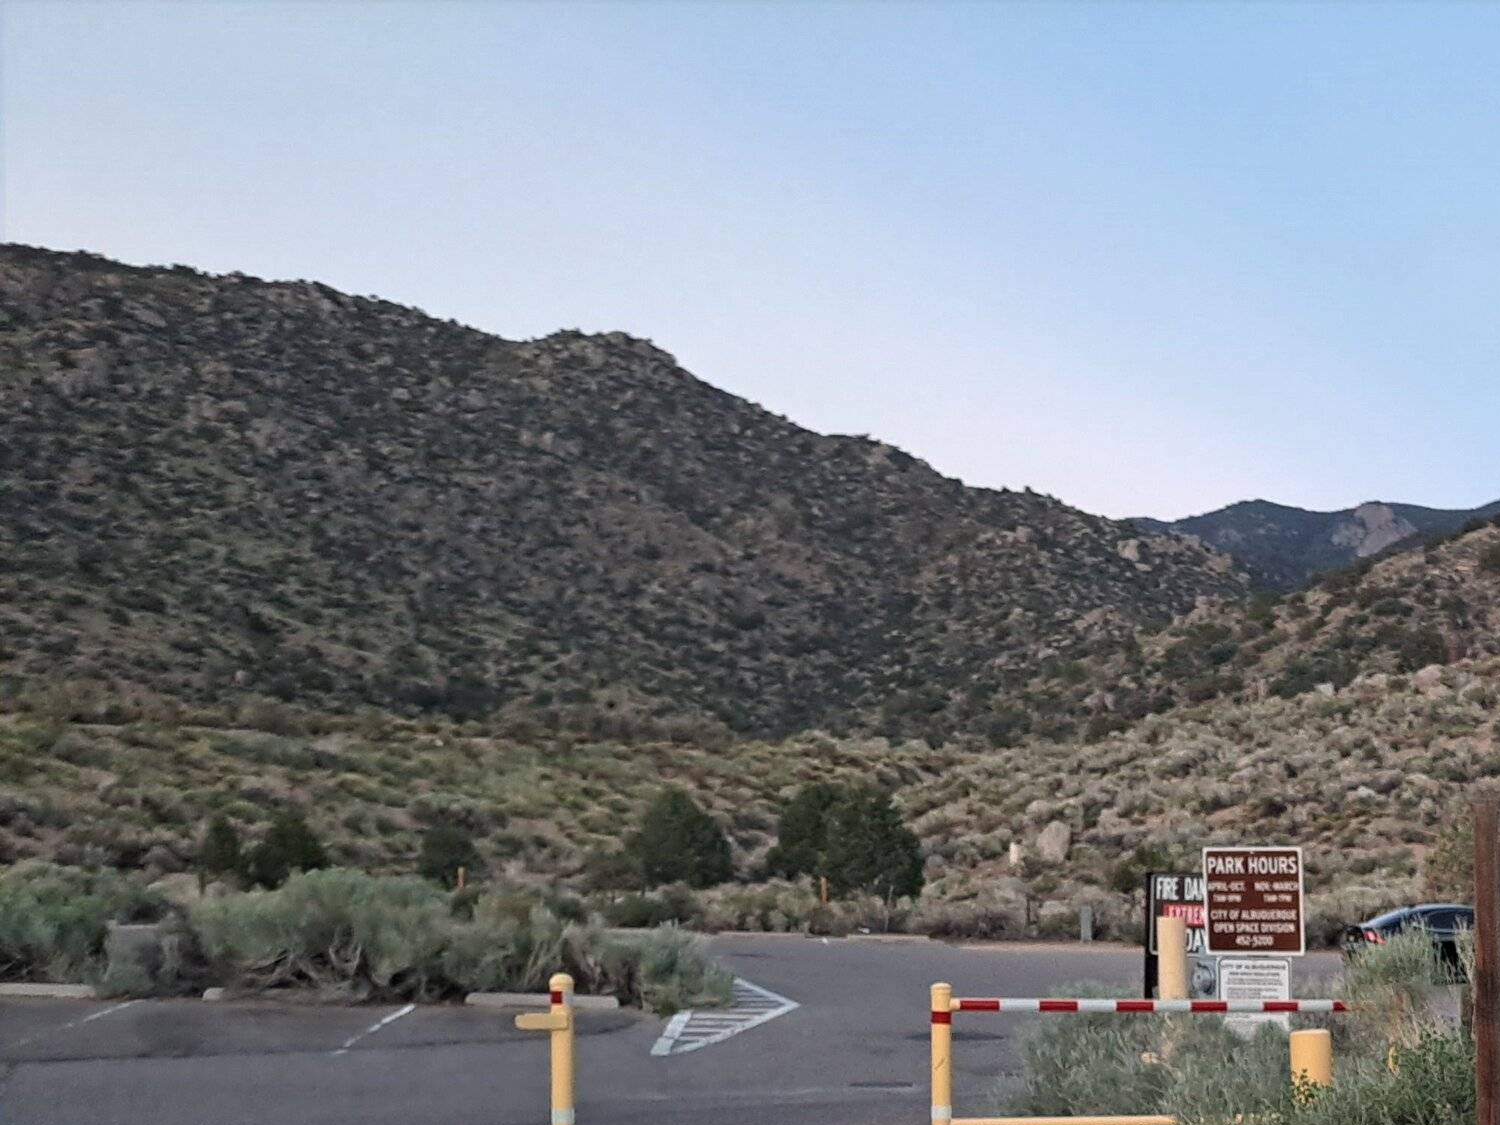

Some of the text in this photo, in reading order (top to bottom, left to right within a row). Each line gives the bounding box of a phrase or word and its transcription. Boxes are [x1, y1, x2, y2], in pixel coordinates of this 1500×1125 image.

[1208, 856, 1297, 874] PARK HOURS
[1156, 877, 1179, 900] FIRE
[1168, 905, 1204, 924] EXTRE
[1210, 909, 1297, 920] CITY OF ALBUQUERQUE
[1213, 922, 1295, 933] OPEN SPACE DIVISION
